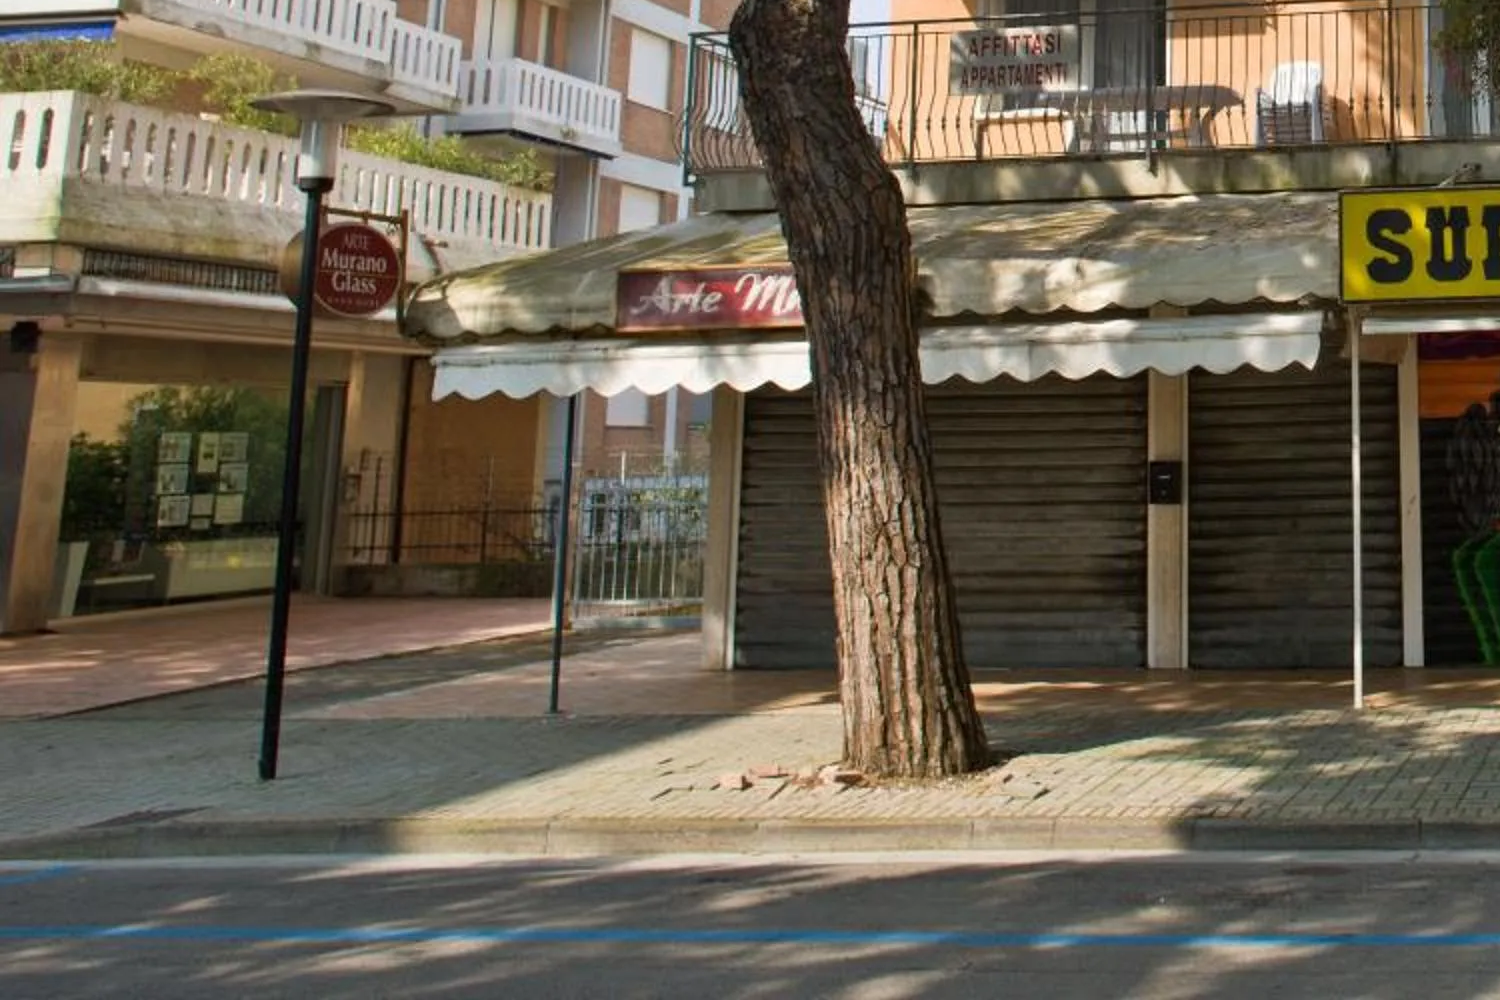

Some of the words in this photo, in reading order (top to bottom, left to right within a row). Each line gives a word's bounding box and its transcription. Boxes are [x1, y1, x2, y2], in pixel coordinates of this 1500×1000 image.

[968, 32, 1062, 57] AFFITTASI
[960, 62, 1067, 89] APPARTAMENTI
[321, 247, 388, 273] Murano
[331, 270, 377, 295] Glass
[630, 274, 724, 315] Arte
